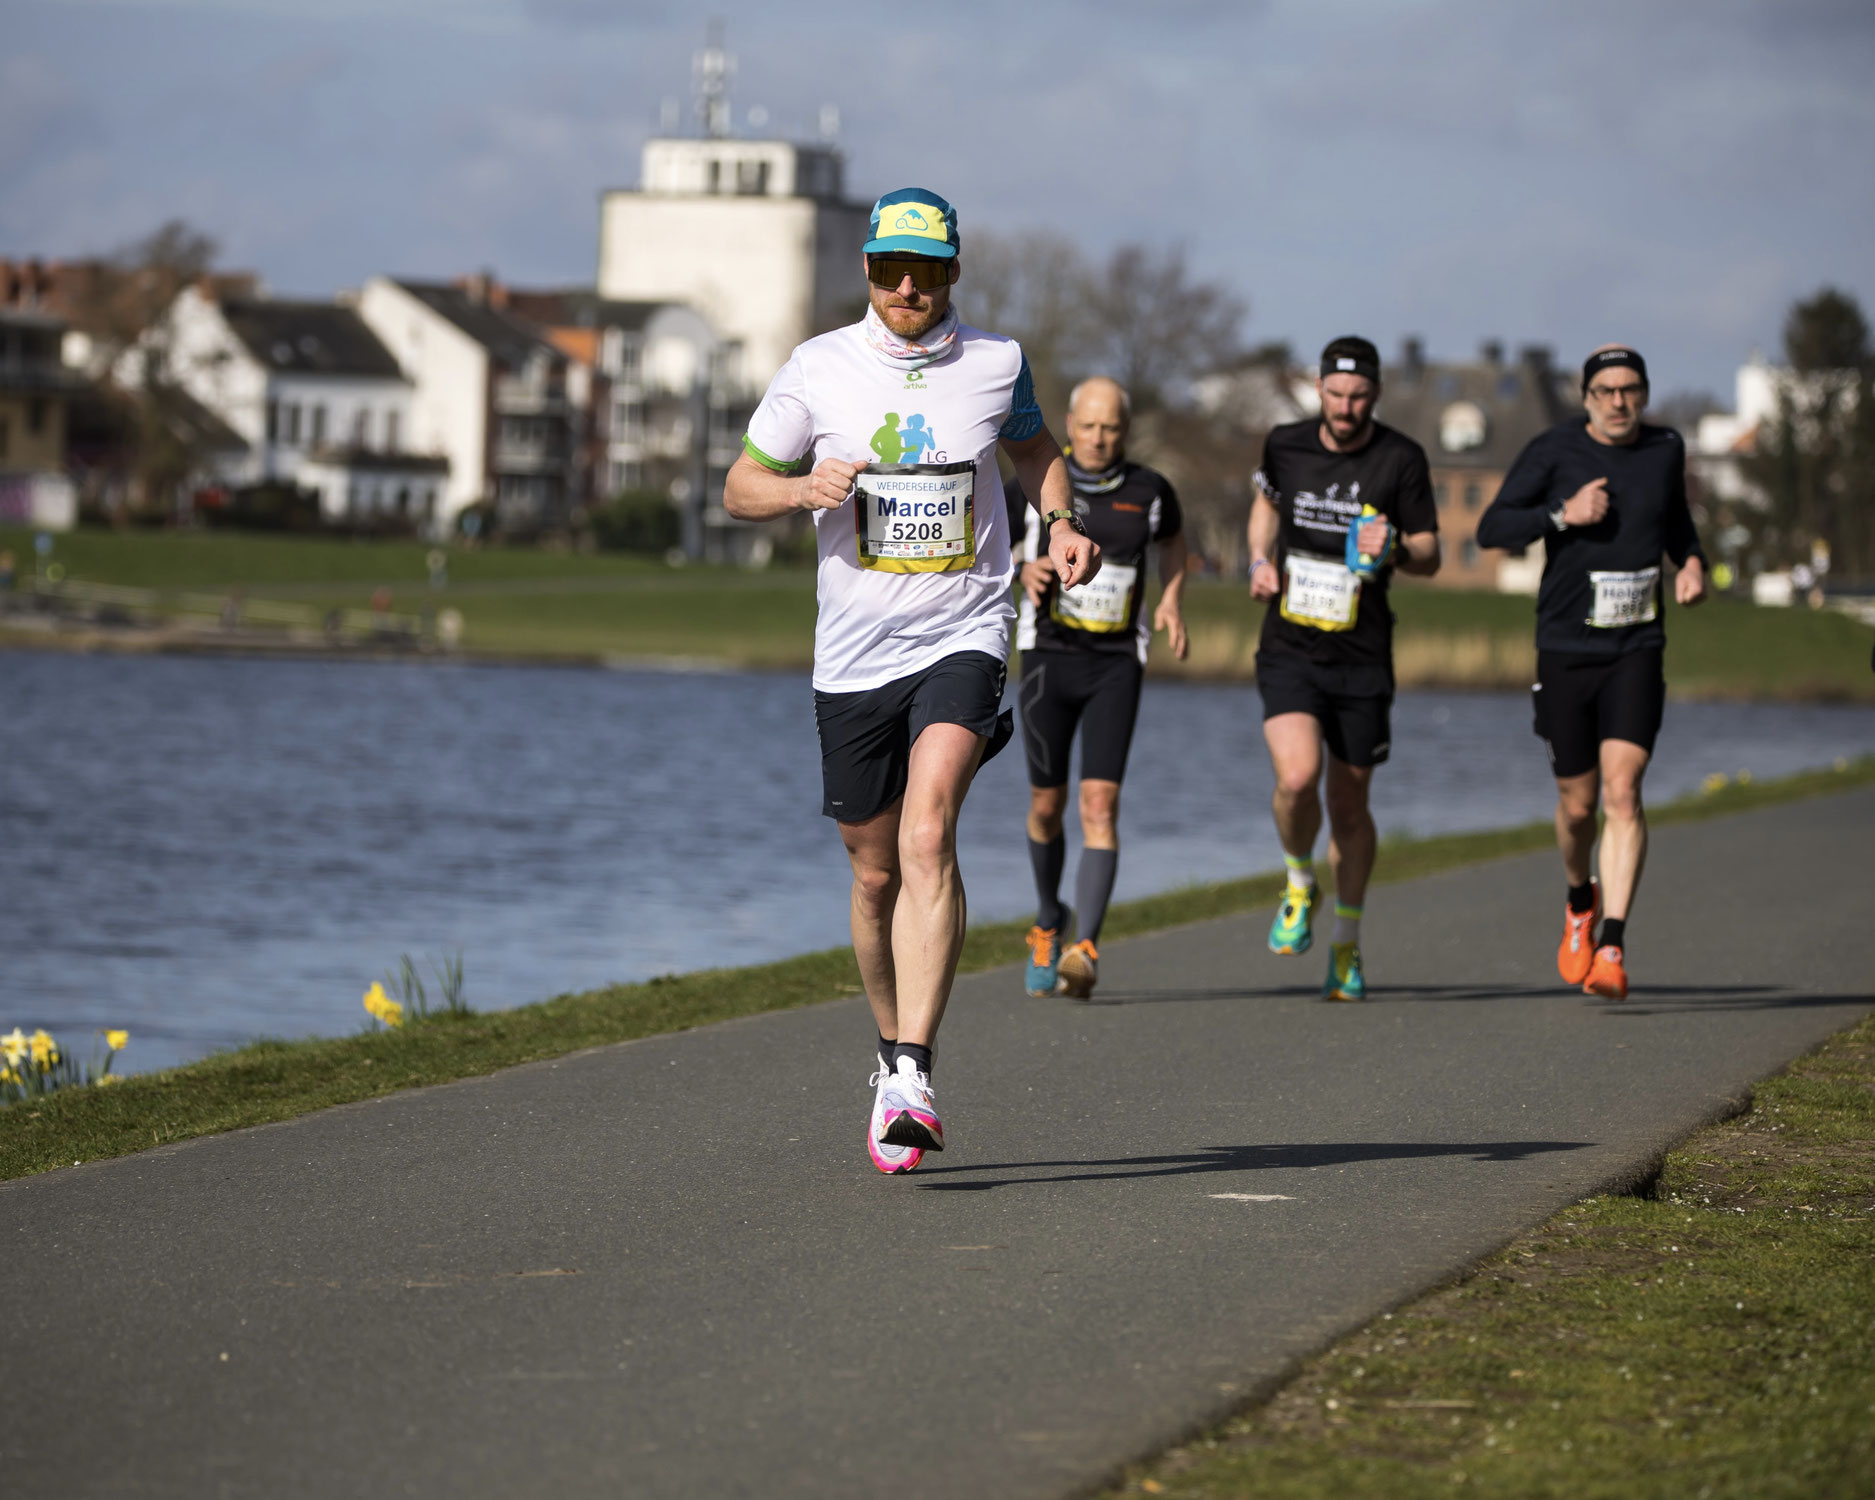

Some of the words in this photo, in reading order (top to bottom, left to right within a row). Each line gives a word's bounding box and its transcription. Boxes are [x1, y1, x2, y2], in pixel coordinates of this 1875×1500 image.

[926, 450, 948, 463] LG
[876, 480, 957, 492] WERDERSEELAUF
[877, 496, 956, 517] Marcel
[892, 522, 943, 540] 5208
